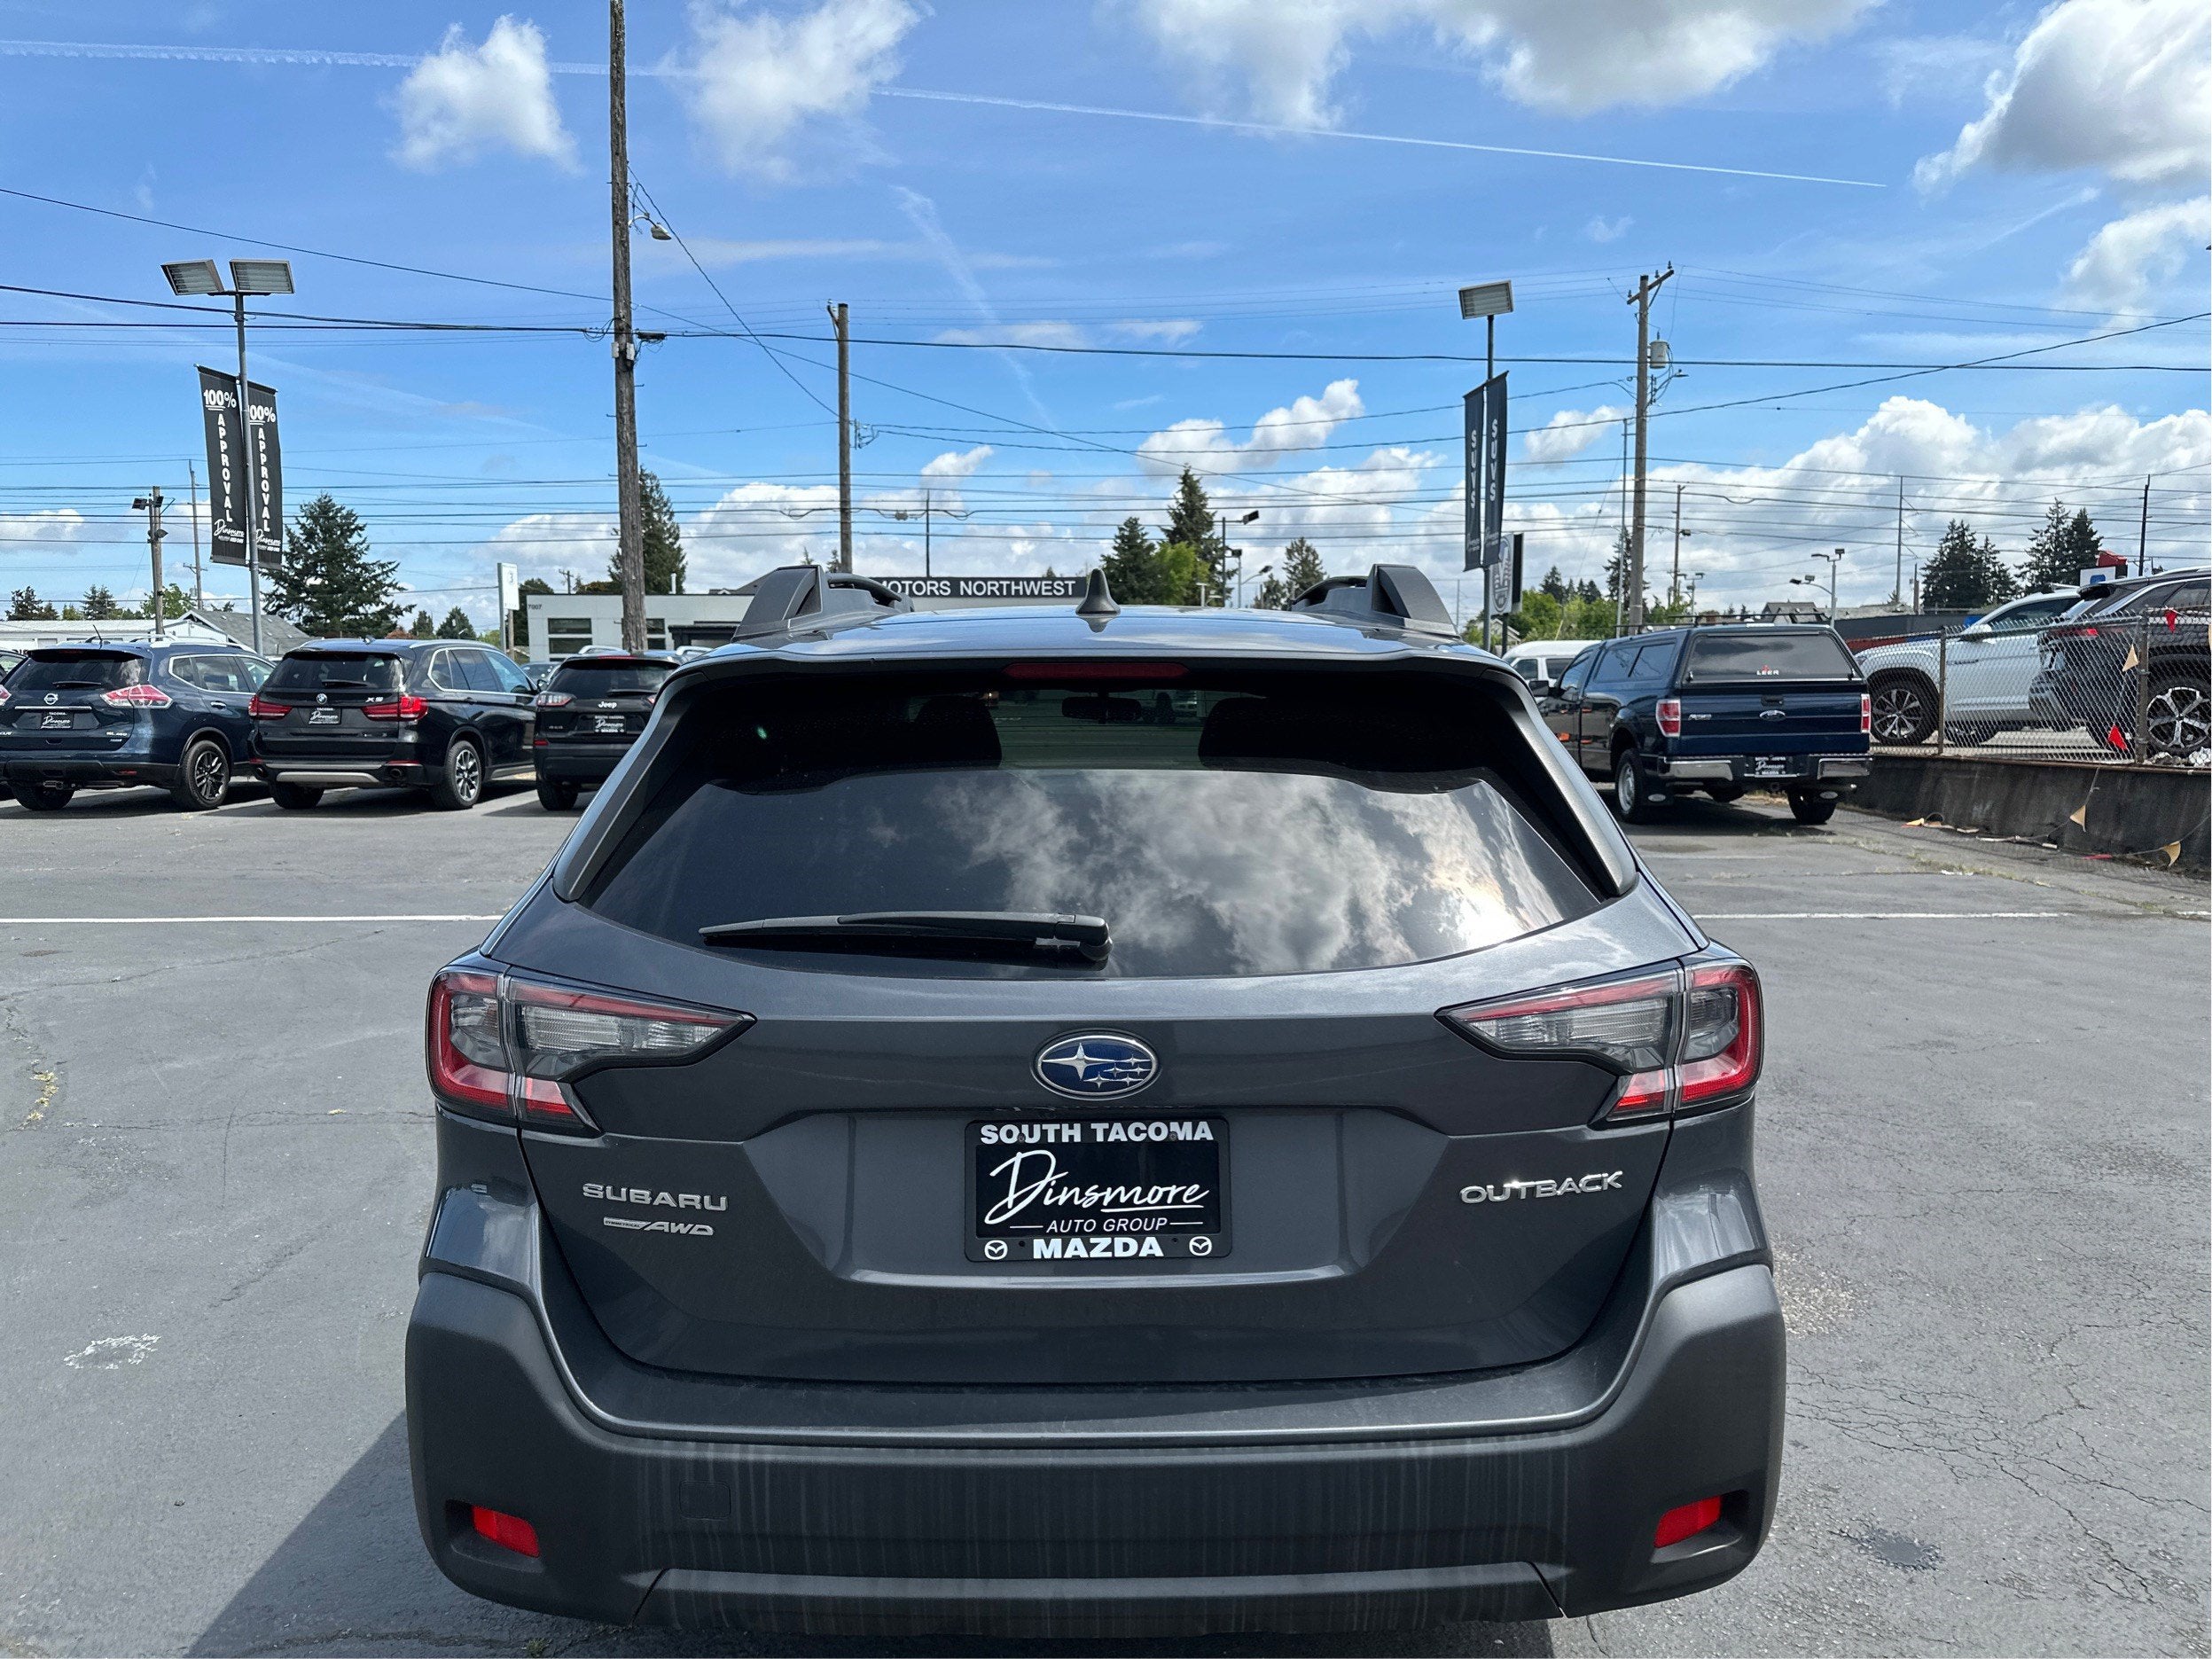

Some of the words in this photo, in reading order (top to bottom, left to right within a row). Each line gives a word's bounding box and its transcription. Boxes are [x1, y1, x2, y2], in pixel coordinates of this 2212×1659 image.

[203, 388, 237, 408] 100%
[217, 413, 233, 523] APPROVAL
[257, 427, 270, 532] APPROVAL
[881, 580, 951, 596] OTORS
[959, 580, 1076, 596] NORTHWEST
[981, 1123, 1081, 1145] SOUTH
[1090, 1121, 1214, 1143] TACOMA
[582, 1183, 729, 1211] SUBARU
[983, 1149, 1210, 1225] Dinsmore
[1459, 1170, 1623, 1204] OUTBACK
[645, 1220, 715, 1236] AWD
[1046, 1219, 1098, 1233] AUTO
[1103, 1217, 1168, 1233] GROUP
[1033, 1236, 1165, 1259] MAZDA
